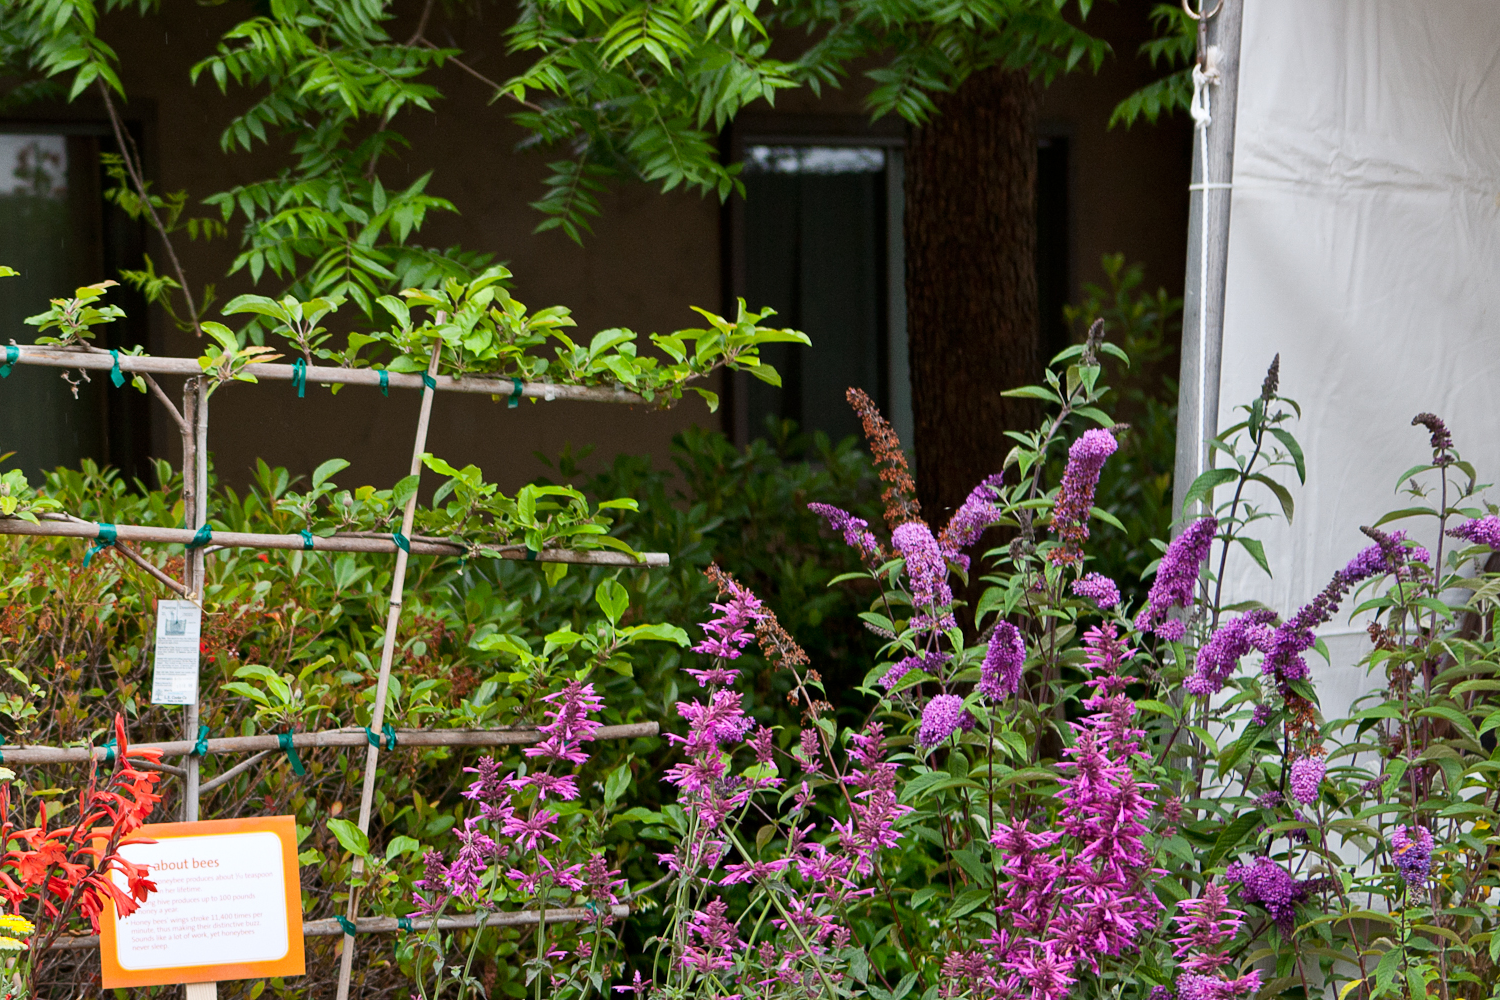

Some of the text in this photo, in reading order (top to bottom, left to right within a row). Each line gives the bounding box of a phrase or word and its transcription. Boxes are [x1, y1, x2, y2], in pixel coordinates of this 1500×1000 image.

[154, 857, 220, 871] about bees
[186, 876, 214, 884] produces
[245, 872, 273, 880] teaspoon
[172, 897, 200, 905] produces
[233, 893, 255, 901] pounds
[170, 917, 189, 926] wings
[211, 913, 232, 921] 11,400
[253, 912, 262, 920] per
[172, 924, 195, 932] making
[210, 931, 220, 939] yet
[222, 929, 255, 937] honeybees
